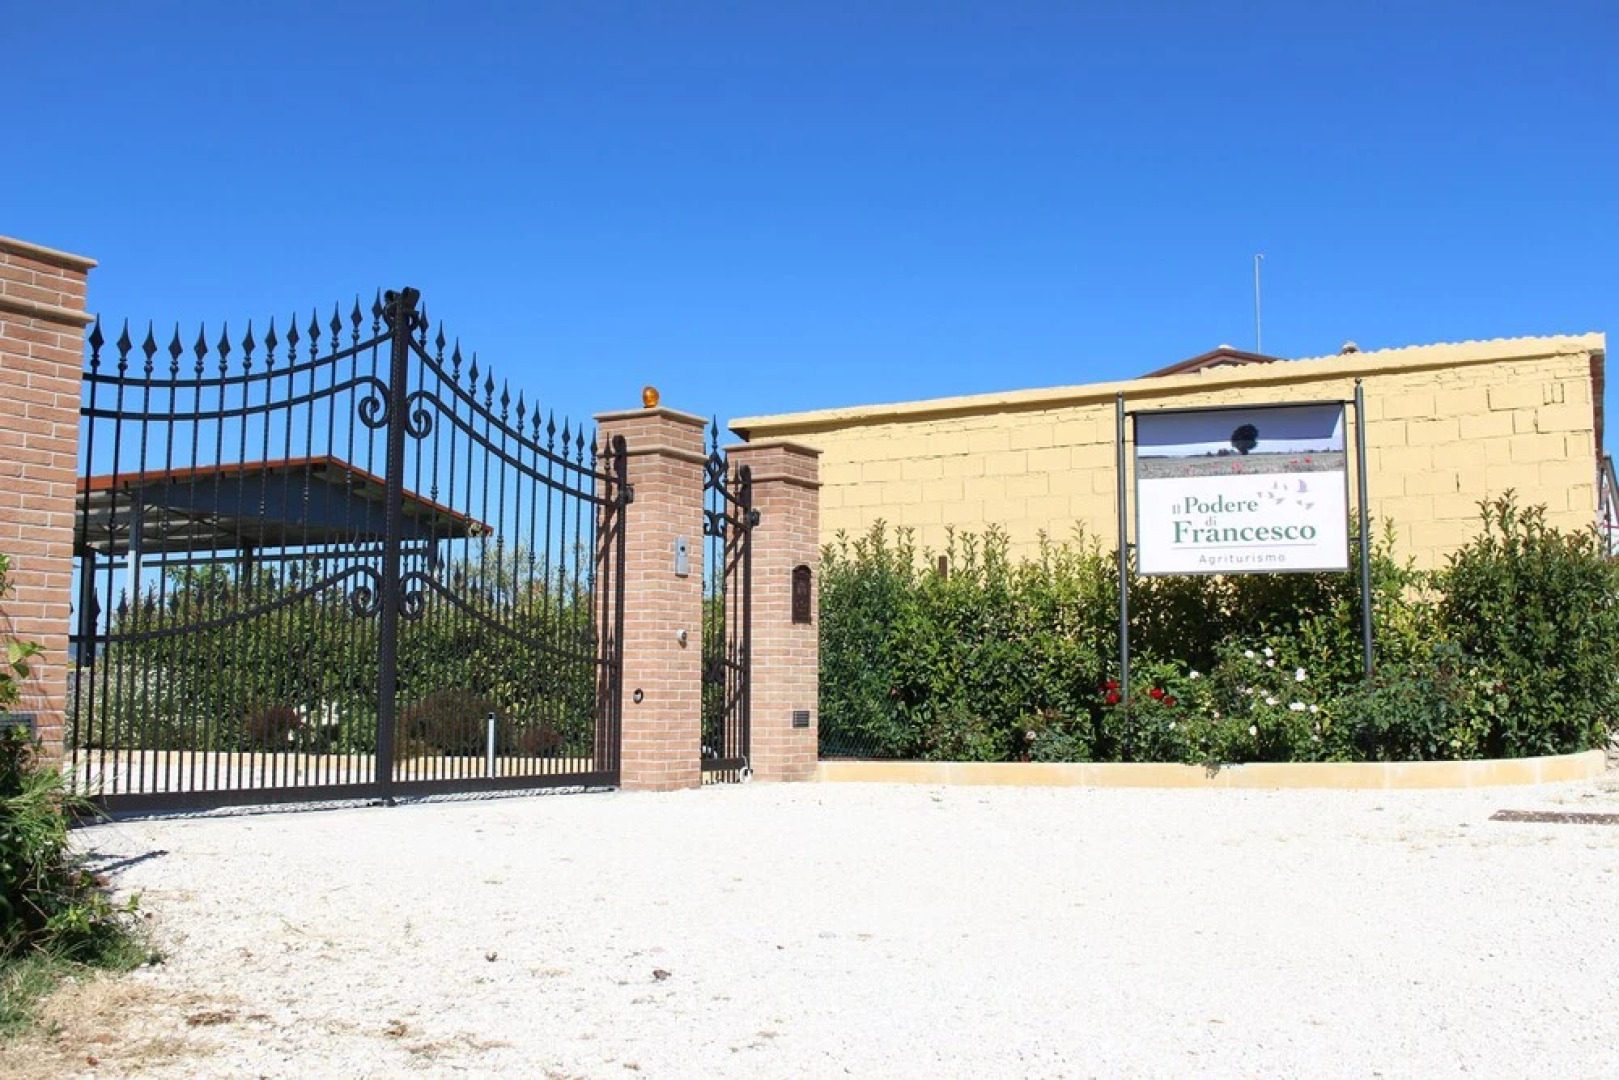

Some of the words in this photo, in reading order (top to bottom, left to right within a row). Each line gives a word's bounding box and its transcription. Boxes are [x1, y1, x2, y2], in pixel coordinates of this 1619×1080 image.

[1172, 504, 1181, 515] Il
[1184, 494, 1259, 514] Podere
[1205, 516, 1217, 527] di
[1173, 520, 1316, 544] Francesco
[1199, 553, 1286, 565] Agriturismo
